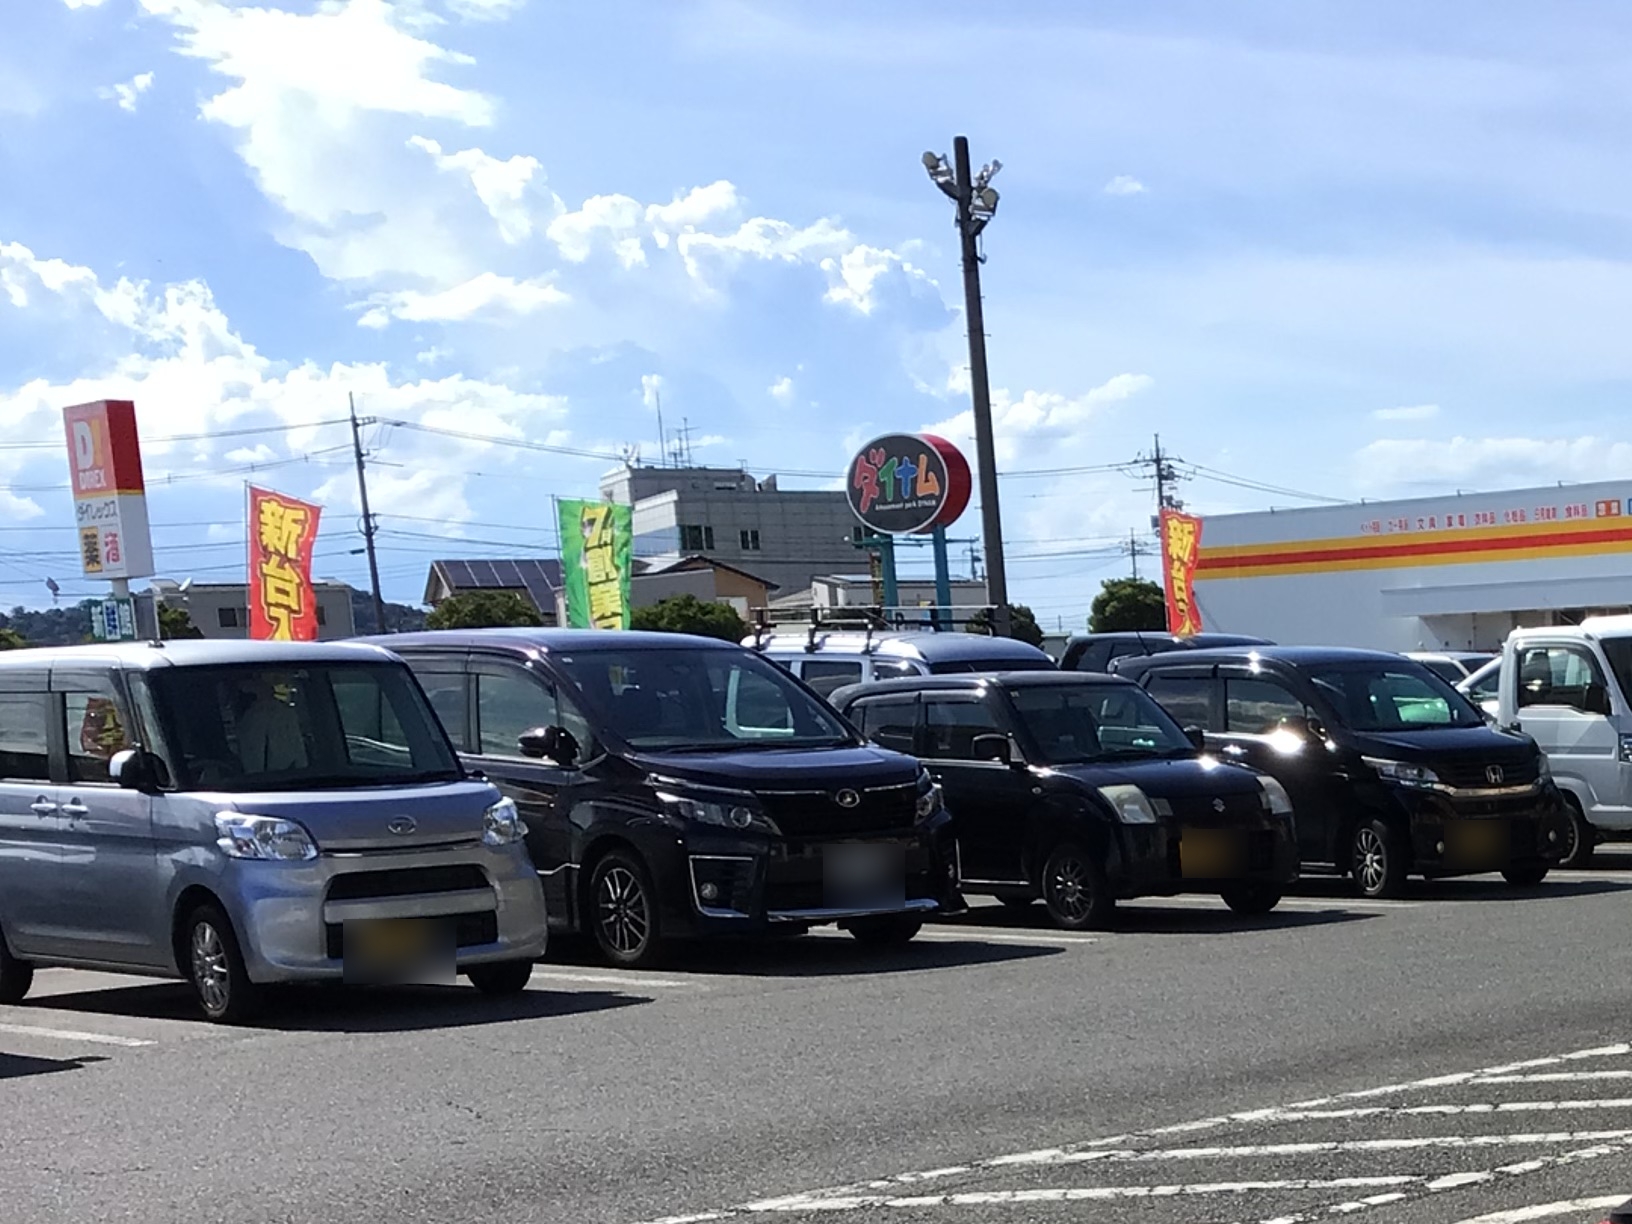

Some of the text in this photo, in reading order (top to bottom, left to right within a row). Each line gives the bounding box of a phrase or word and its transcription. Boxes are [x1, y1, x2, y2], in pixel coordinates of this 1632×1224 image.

[79, 468, 107, 490] DIREX
[854, 447, 941, 514] ダイナム
[78, 500, 118, 522] ダイレックス
